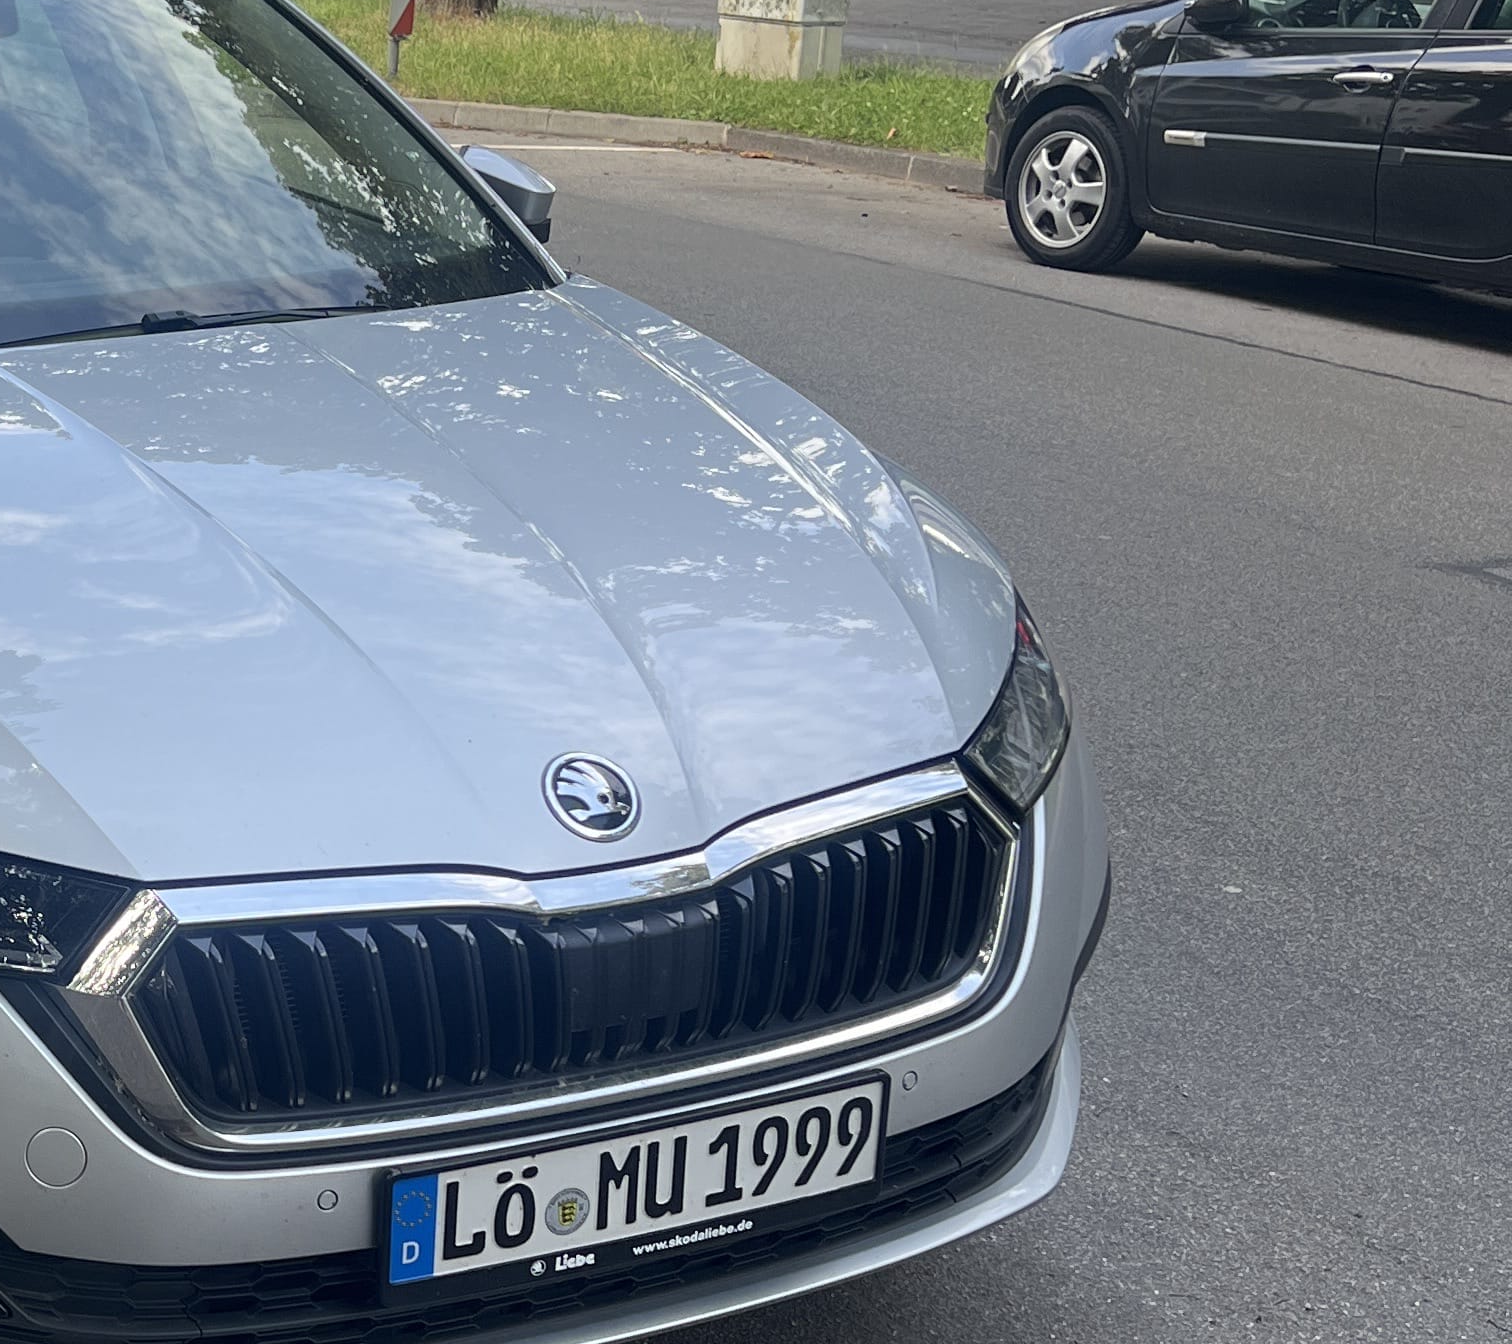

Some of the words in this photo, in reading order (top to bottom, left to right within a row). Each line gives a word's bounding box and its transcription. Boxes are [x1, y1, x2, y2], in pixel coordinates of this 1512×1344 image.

[441, 1165, 538, 1260] LÖ
[596, 1134, 687, 1230] MU
[704, 1096, 874, 1208] 1999
[401, 1240, 420, 1265] D
[632, 1219, 754, 1256] www.skodaliebe.de
[554, 1253, 596, 1272] Liebe
